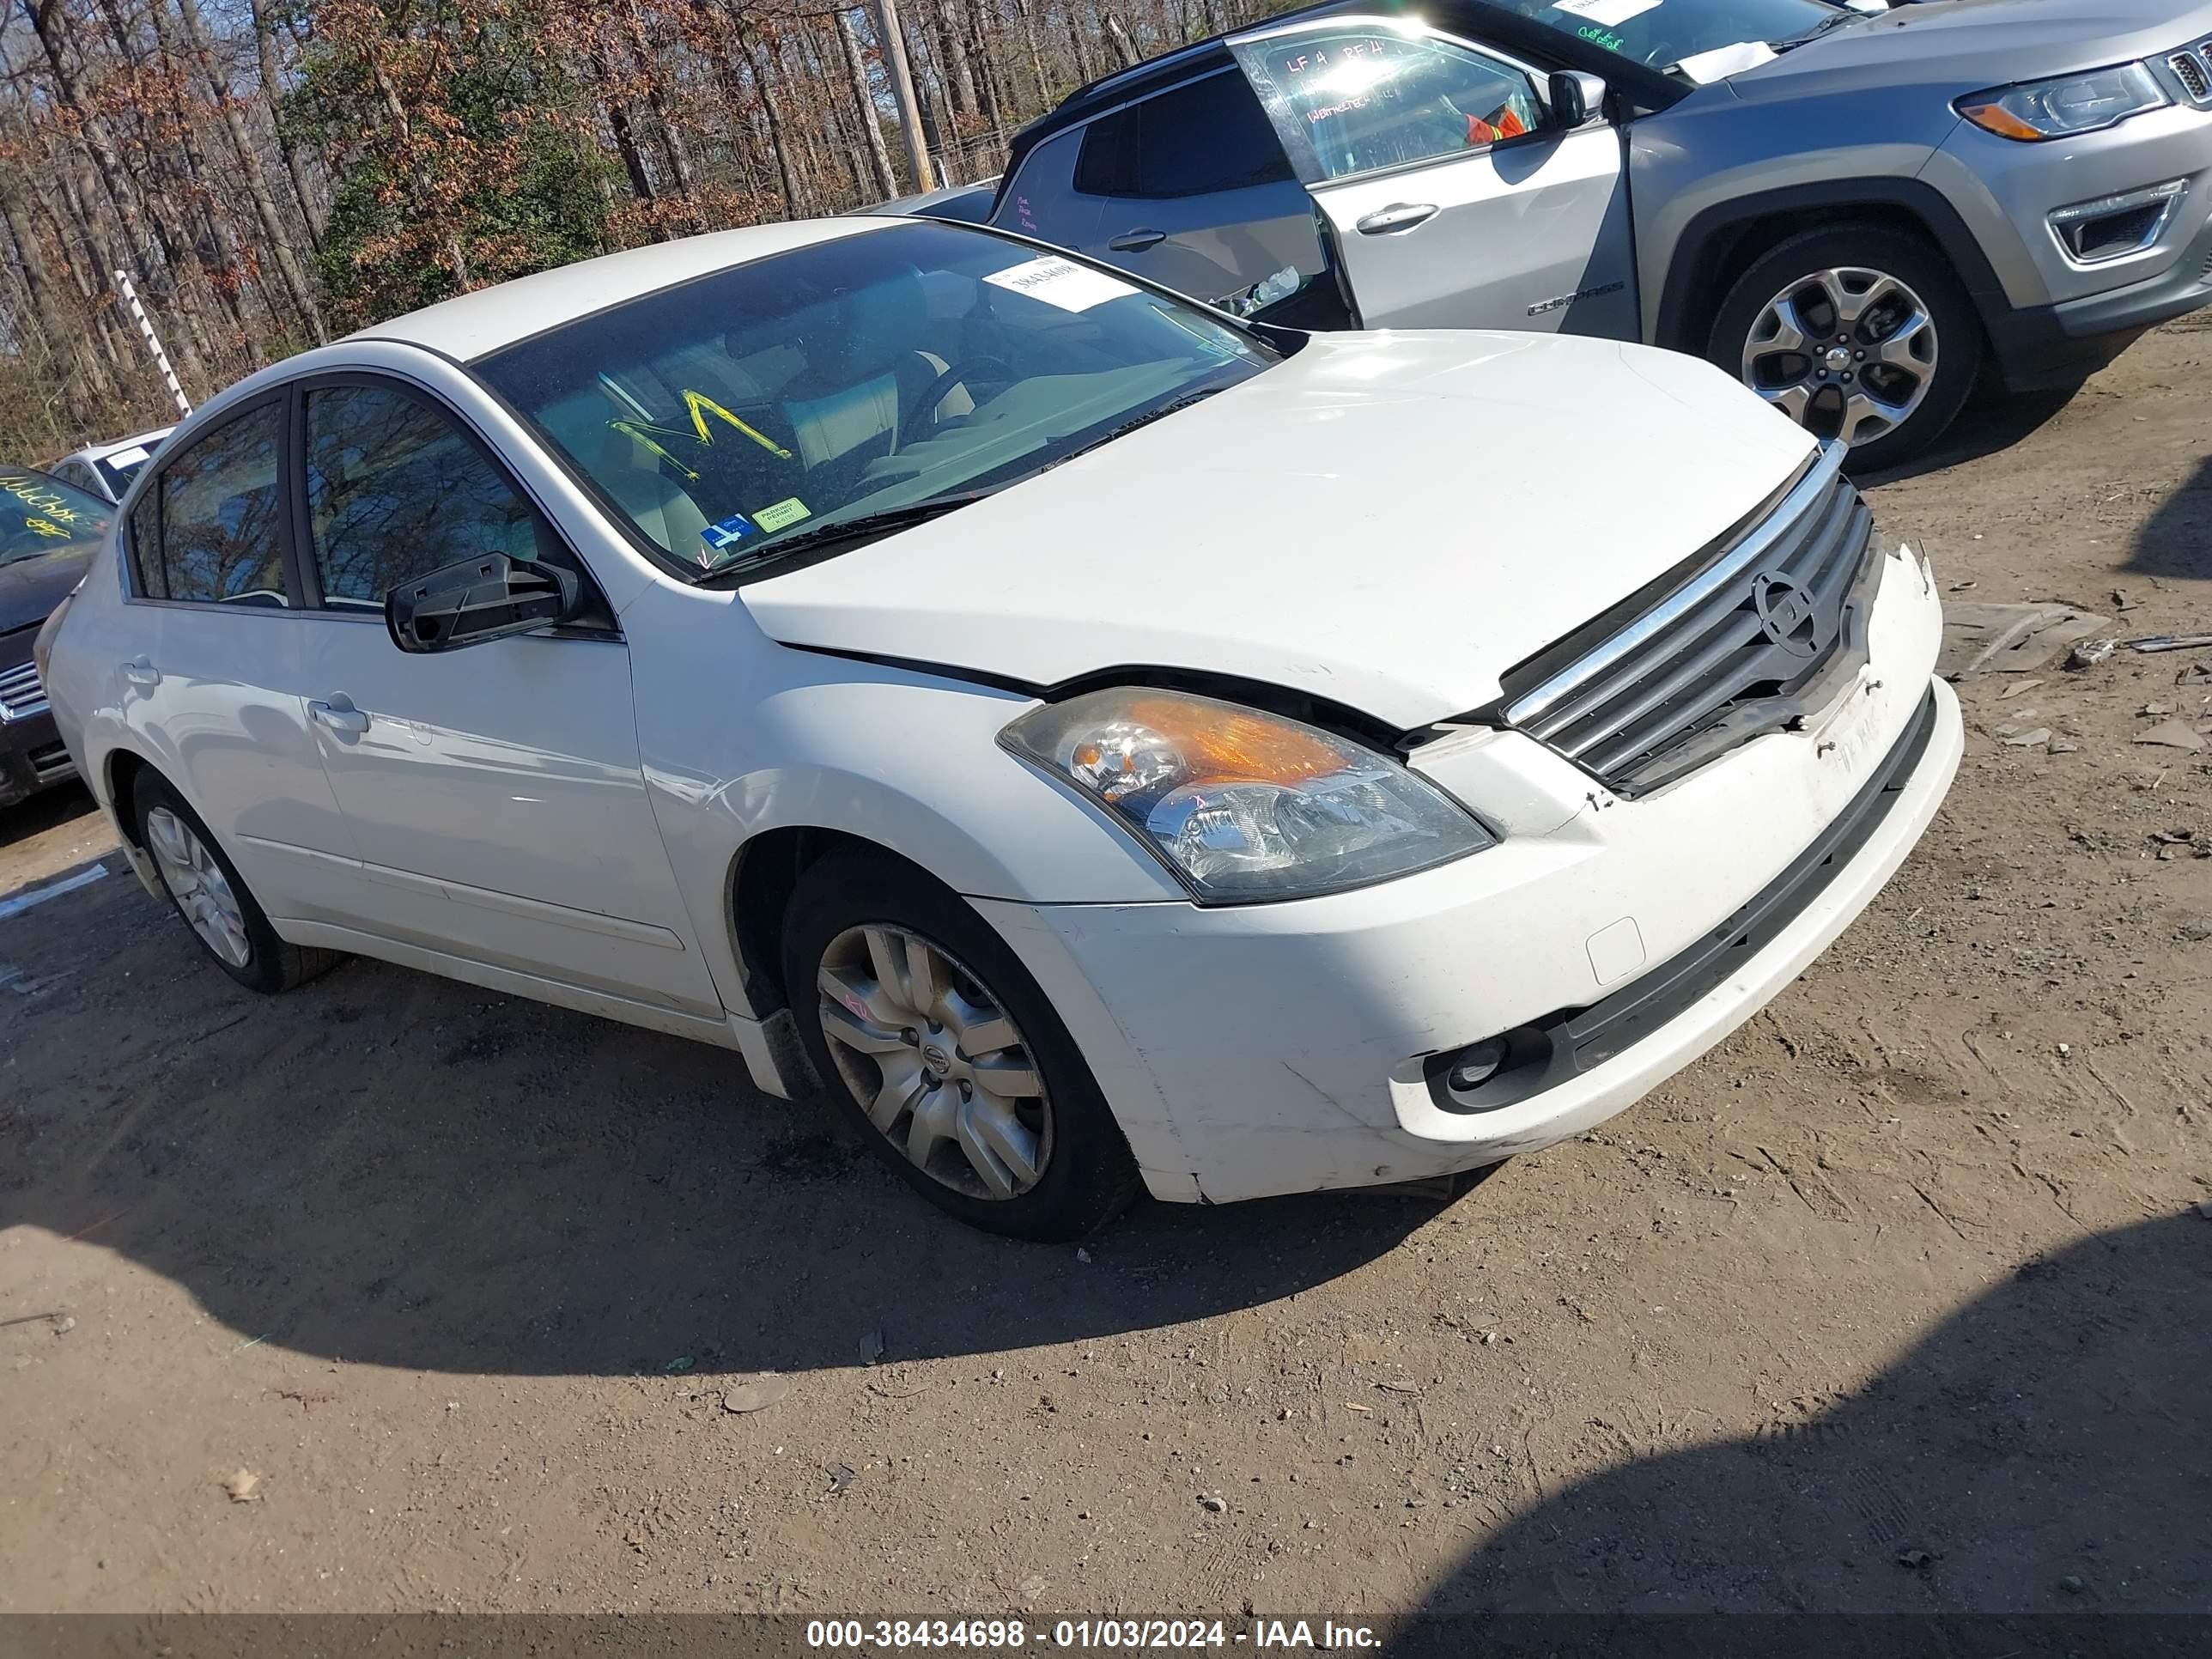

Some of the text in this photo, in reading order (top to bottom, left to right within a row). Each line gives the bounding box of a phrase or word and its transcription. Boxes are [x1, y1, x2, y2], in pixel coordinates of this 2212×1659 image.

[1012, 264, 1079, 289] 38434698
[1528, 281, 1625, 316] COMPASS
[761, 502, 793, 518] PARKING
[767, 507, 793, 521] PERMIT
